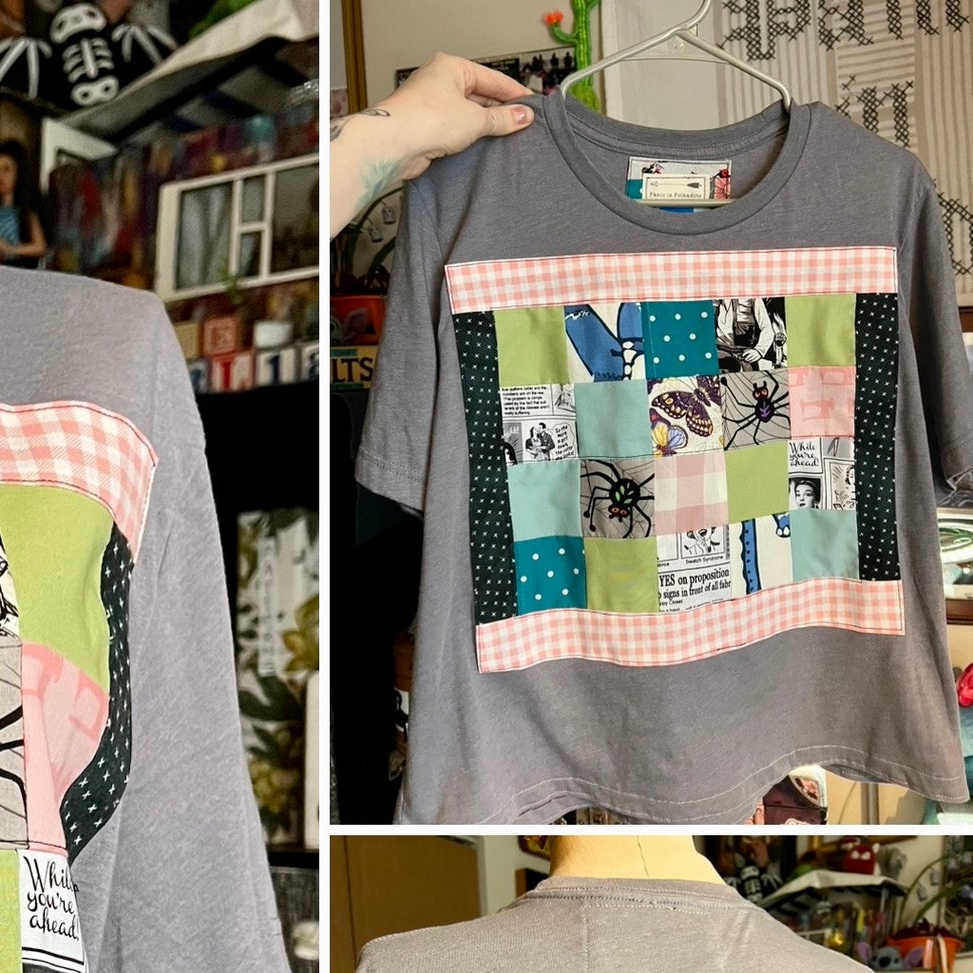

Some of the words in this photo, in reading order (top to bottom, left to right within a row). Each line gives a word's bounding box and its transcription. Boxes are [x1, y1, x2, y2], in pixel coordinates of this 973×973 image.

[659, 574, 675, 587] YES
[678, 576, 688, 585] on
[689, 568, 729, 588] proposition
[663, 589, 680, 600] signs
[681, 587, 688, 596] in
[689, 585, 703, 596] front
[705, 582, 711, 591] of
[719, 580, 731, 588] fabr
[27, 891, 75, 915] you're
